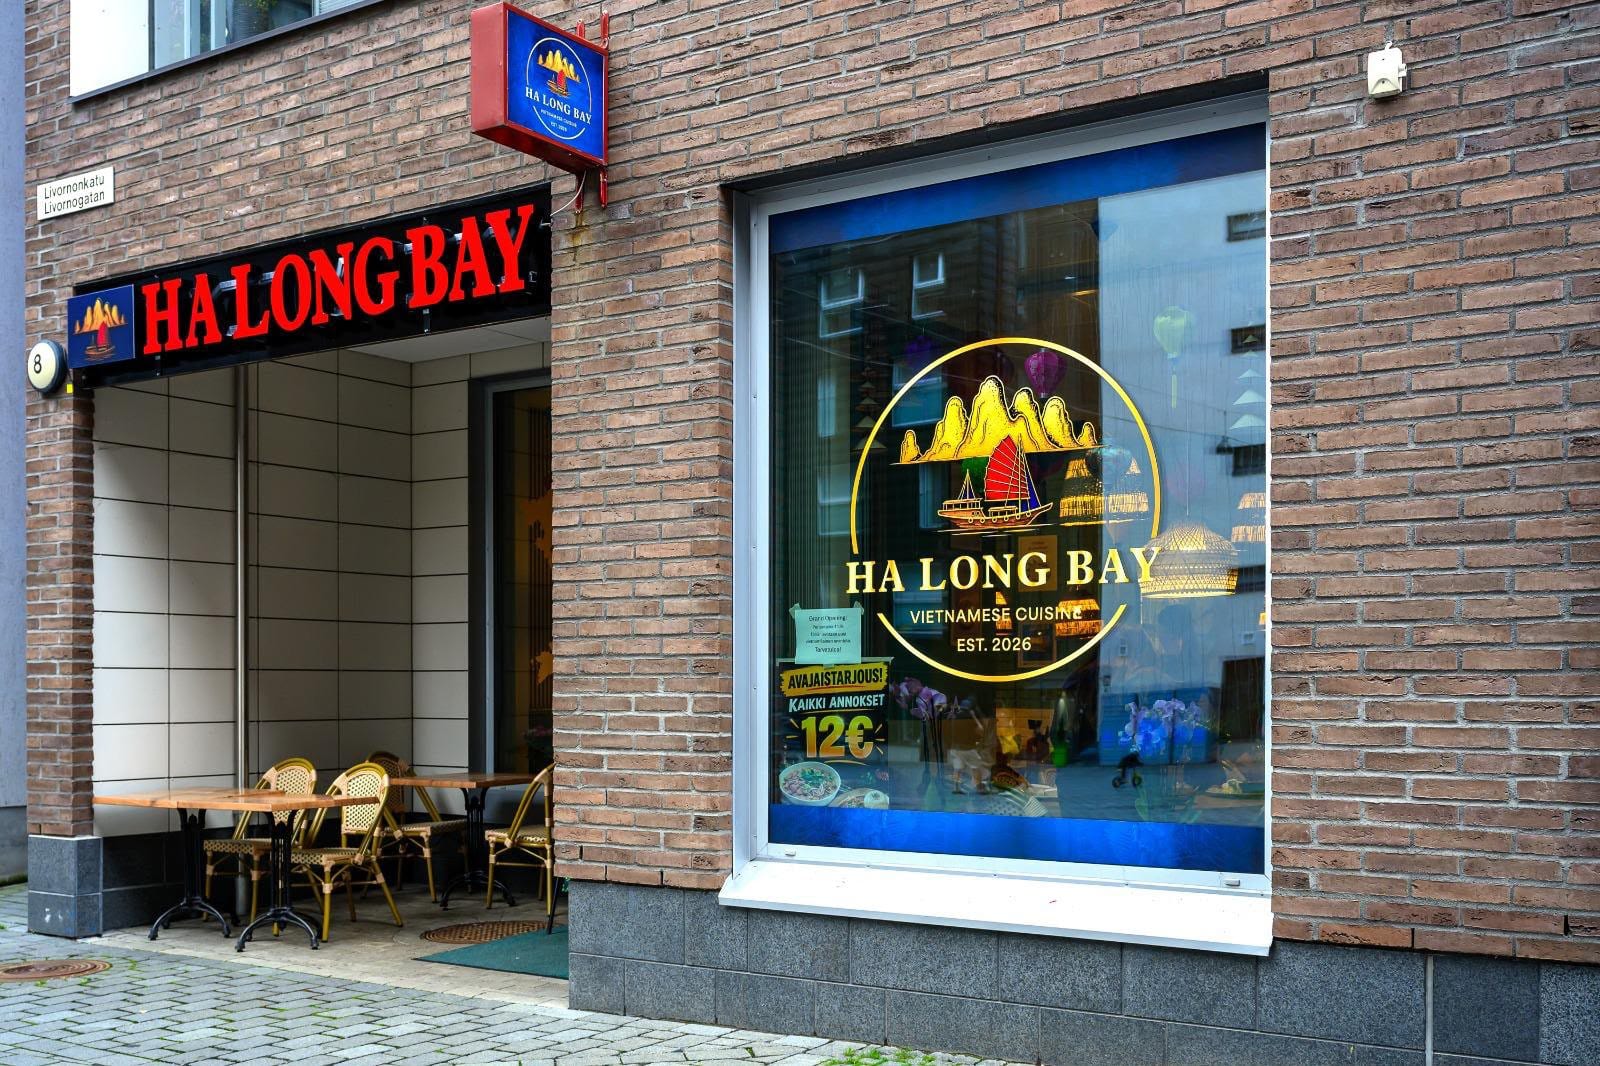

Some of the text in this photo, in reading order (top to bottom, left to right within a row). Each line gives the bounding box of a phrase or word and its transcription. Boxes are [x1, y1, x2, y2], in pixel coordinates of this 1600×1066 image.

[525, 86, 540, 102] HA
[542, 94, 571, 116] LONG
[573, 107, 592, 125] BAY
[44, 174, 105, 199] Livornonkatu
[44, 191, 105, 215] Livornogatan
[141, 204, 535, 355] HA LONG BAY
[33, 354, 42, 374] 8
[846, 547, 1163, 594] HA LONG BAY
[910, 606, 1083, 624] VIETNAMESE CUISINE
[957, 637, 1031, 652] EST. 2026
[788, 668, 883, 690] AVAJAISTARJOUS!
[788, 694, 885, 713] KAIKKI ANNOKSET
[802, 715, 874, 759] 12€
